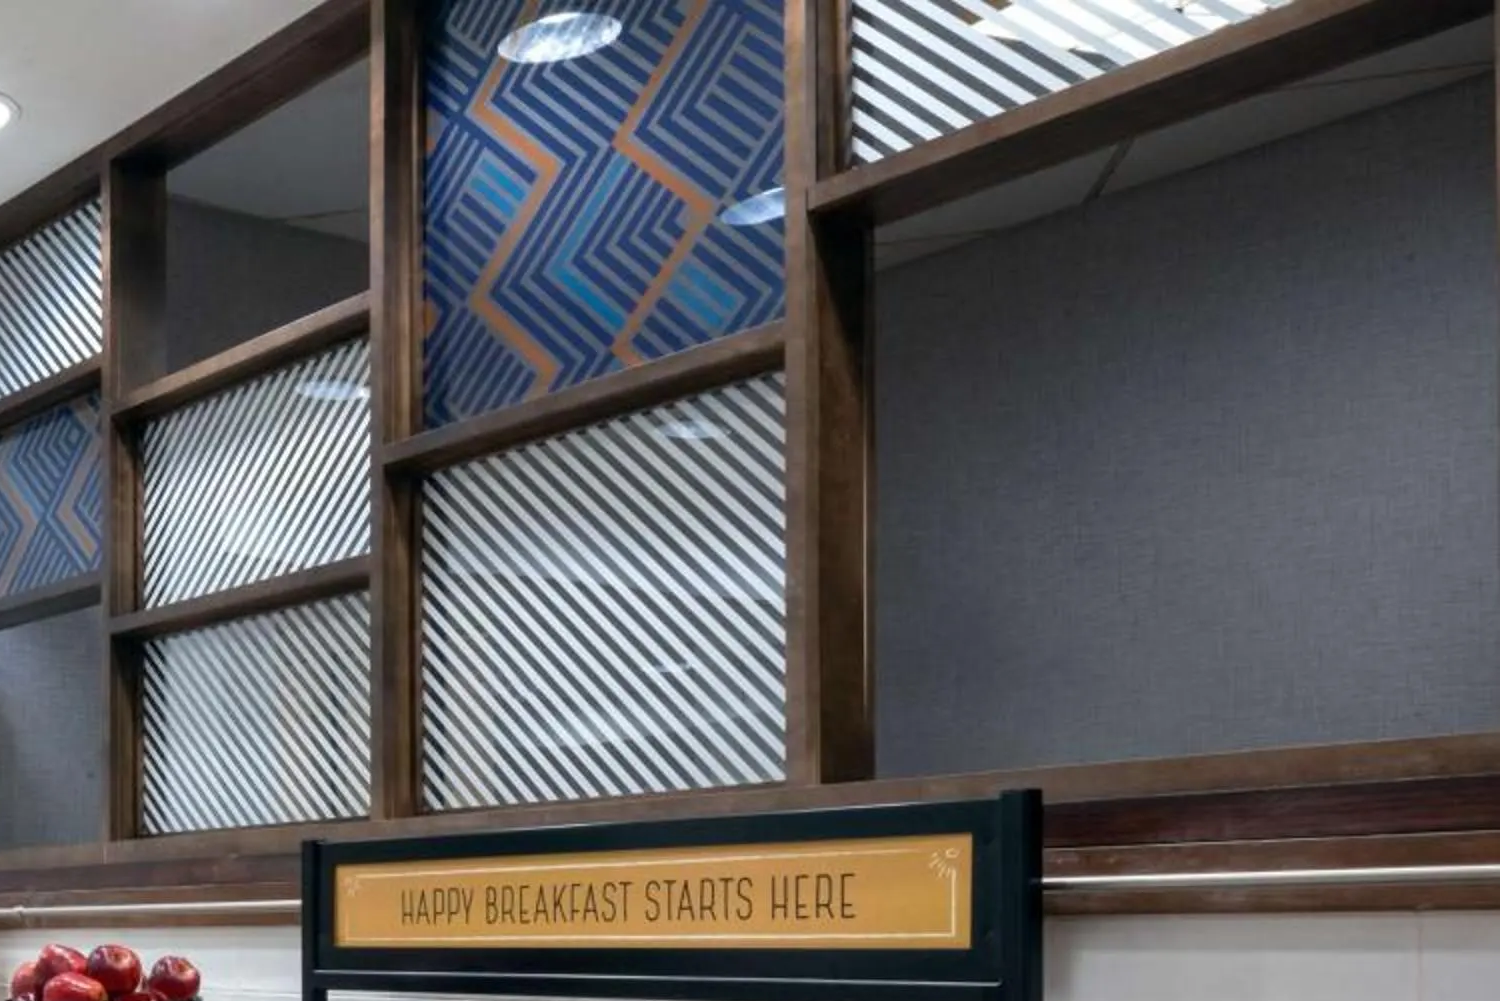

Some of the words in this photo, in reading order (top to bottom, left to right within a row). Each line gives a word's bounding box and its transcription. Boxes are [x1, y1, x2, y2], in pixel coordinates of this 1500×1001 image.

[401, 886, 475, 926] HAPPY
[485, 881, 633, 925] BREAKFAST
[644, 876, 754, 922] STARTS
[771, 872, 857, 920] HERE
